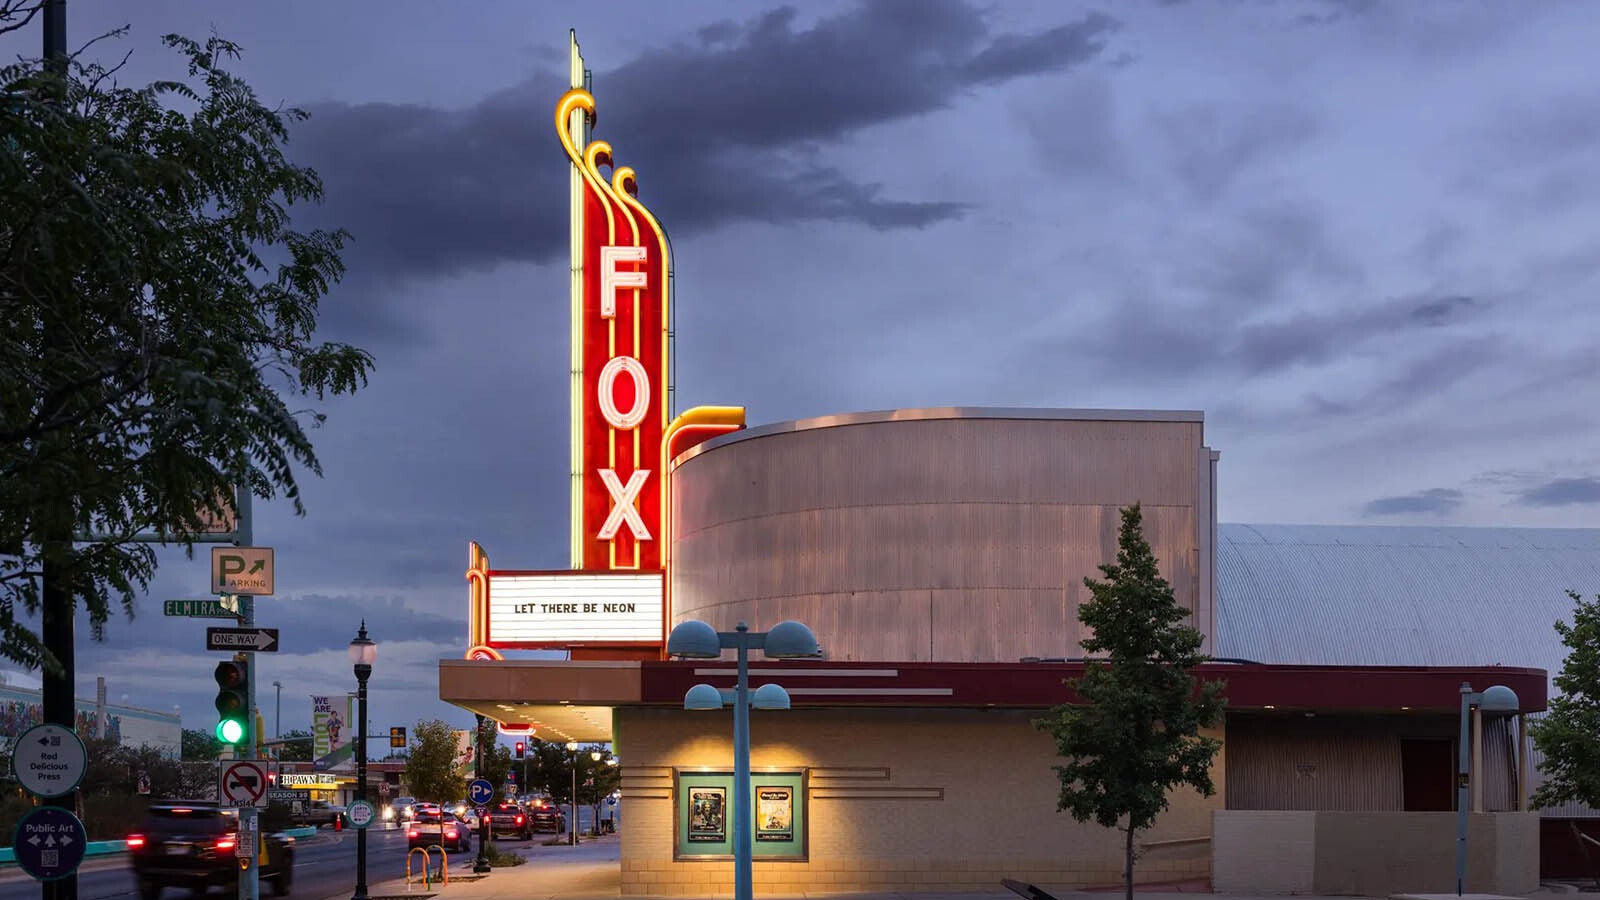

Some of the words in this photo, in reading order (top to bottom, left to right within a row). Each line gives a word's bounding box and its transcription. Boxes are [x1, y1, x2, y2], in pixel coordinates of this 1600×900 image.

[597, 246, 652, 540] FOX
[166, 602, 215, 615] ELMIRA
[515, 604, 536, 614] LET
[541, 604, 578, 614] THERE
[584, 604, 597, 613] BE
[604, 603, 635, 613] NEON
[214, 634, 233, 644] ONE
[237, 635, 257, 645] WAY
[472, 785, 481, 798] P
[26, 824, 56, 832] Public
[58, 824, 74, 832] Art
